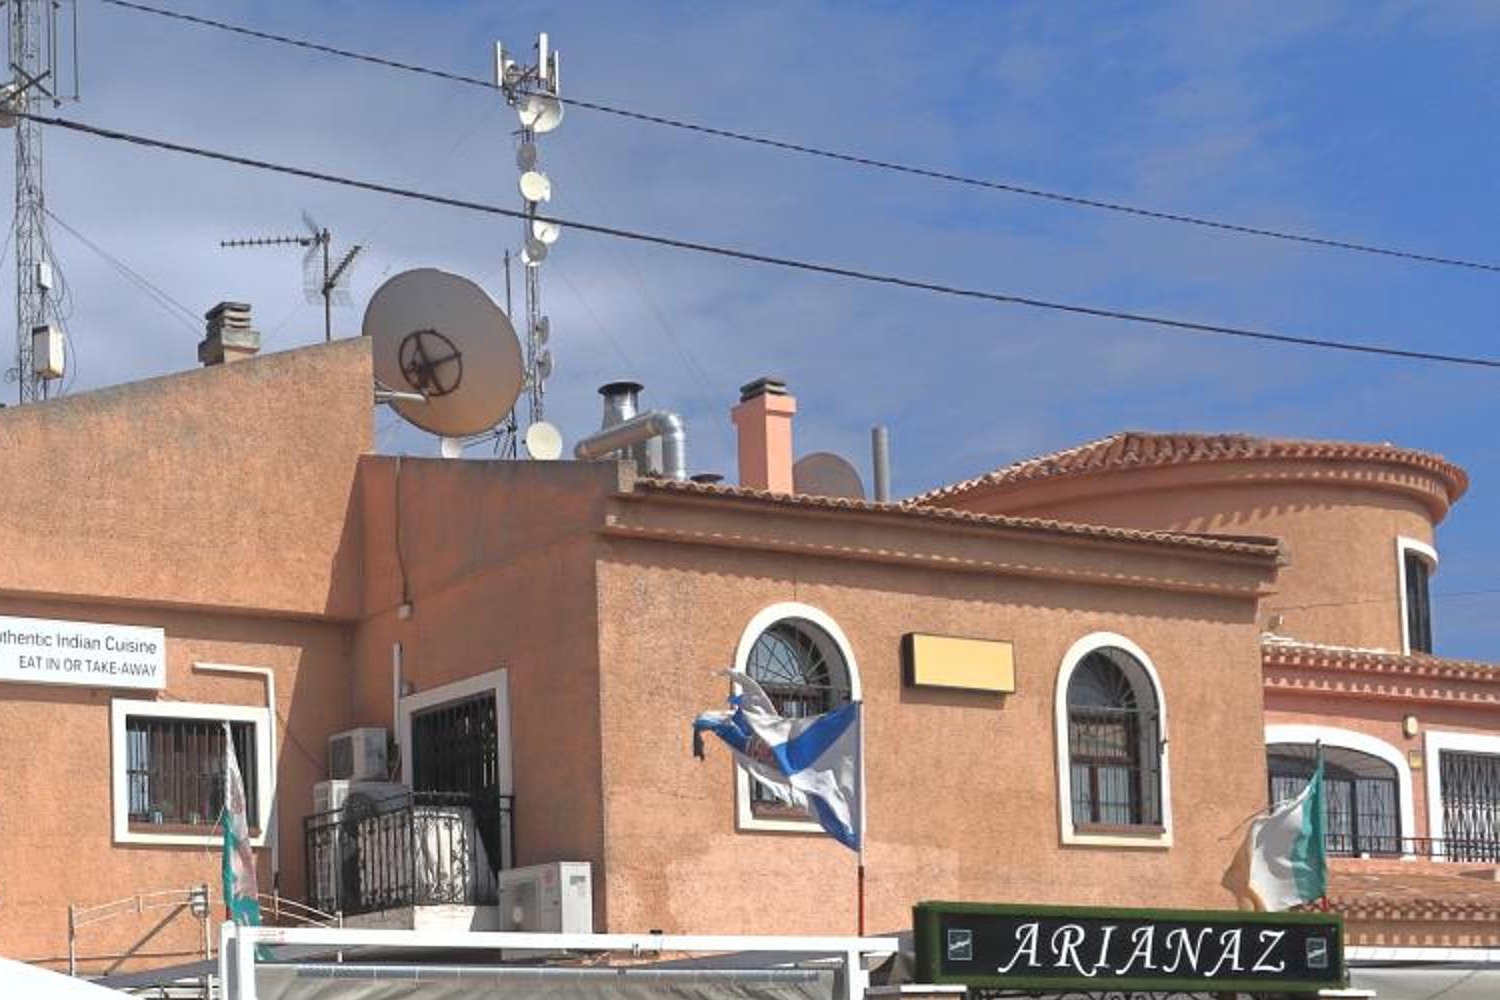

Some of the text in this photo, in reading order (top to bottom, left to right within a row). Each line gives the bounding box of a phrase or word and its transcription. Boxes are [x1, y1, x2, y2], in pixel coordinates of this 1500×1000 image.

[56, 632, 101, 650] Indian
[105, 635, 157, 655] Cuisine
[19, 655, 157, 677] EAT IN OR TAKE-AWAY
[997, 922, 1286, 977] ARIANAZ
